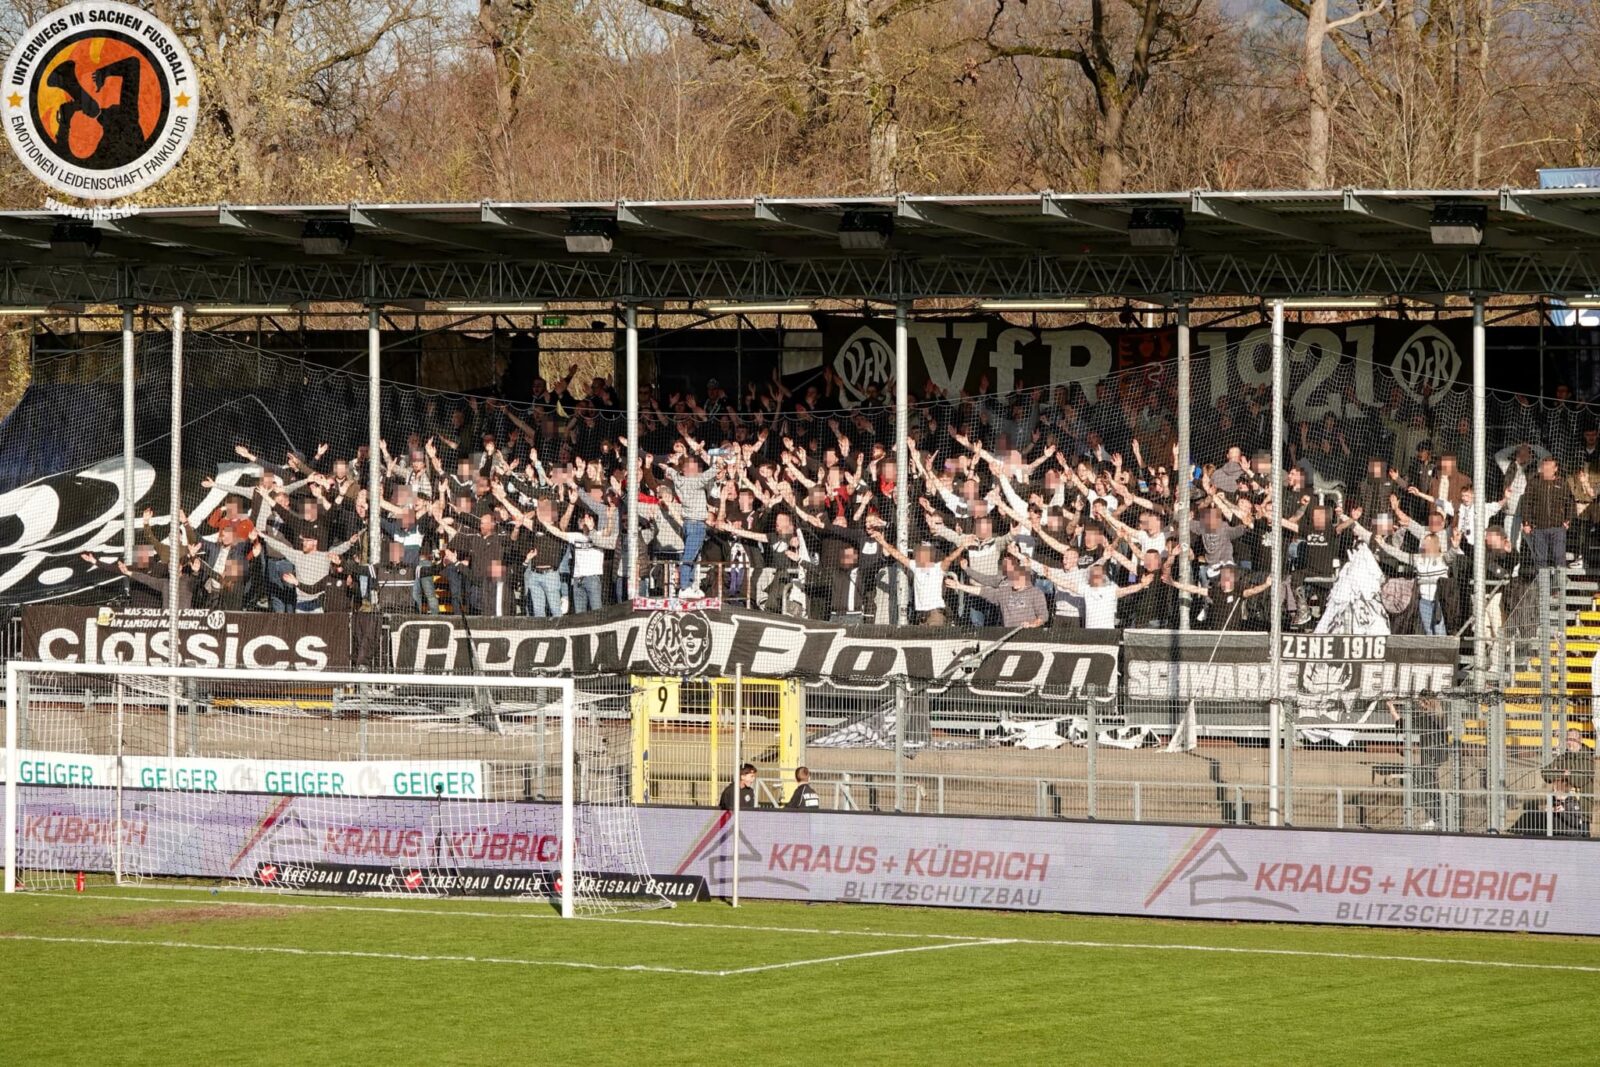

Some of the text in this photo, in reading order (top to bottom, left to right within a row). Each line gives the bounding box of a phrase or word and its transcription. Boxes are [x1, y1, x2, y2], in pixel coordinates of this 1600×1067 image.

[908, 322, 1112, 405] VfR
[1197, 324, 1384, 422] 1921
[38, 618, 328, 672] classics
[1268, 636, 1386, 659] ZENE 1916
[1360, 662, 1454, 698] ELITE
[658, 686, 668, 713] 9
[20, 760, 93, 785] GEIGER
[265, 771, 344, 795] GEIGER
[393, 772, 475, 795] GEIGER
[323, 826, 422, 858] KRAUS
[768, 843, 1050, 881] KRAUS + KÜBRICH
[843, 881, 1042, 907] BLITZSCHUTZBAU
[1255, 862, 1558, 903] KRAUS + KÜBRICH
[1336, 903, 1549, 929] BLITZSCHUTZBAU
